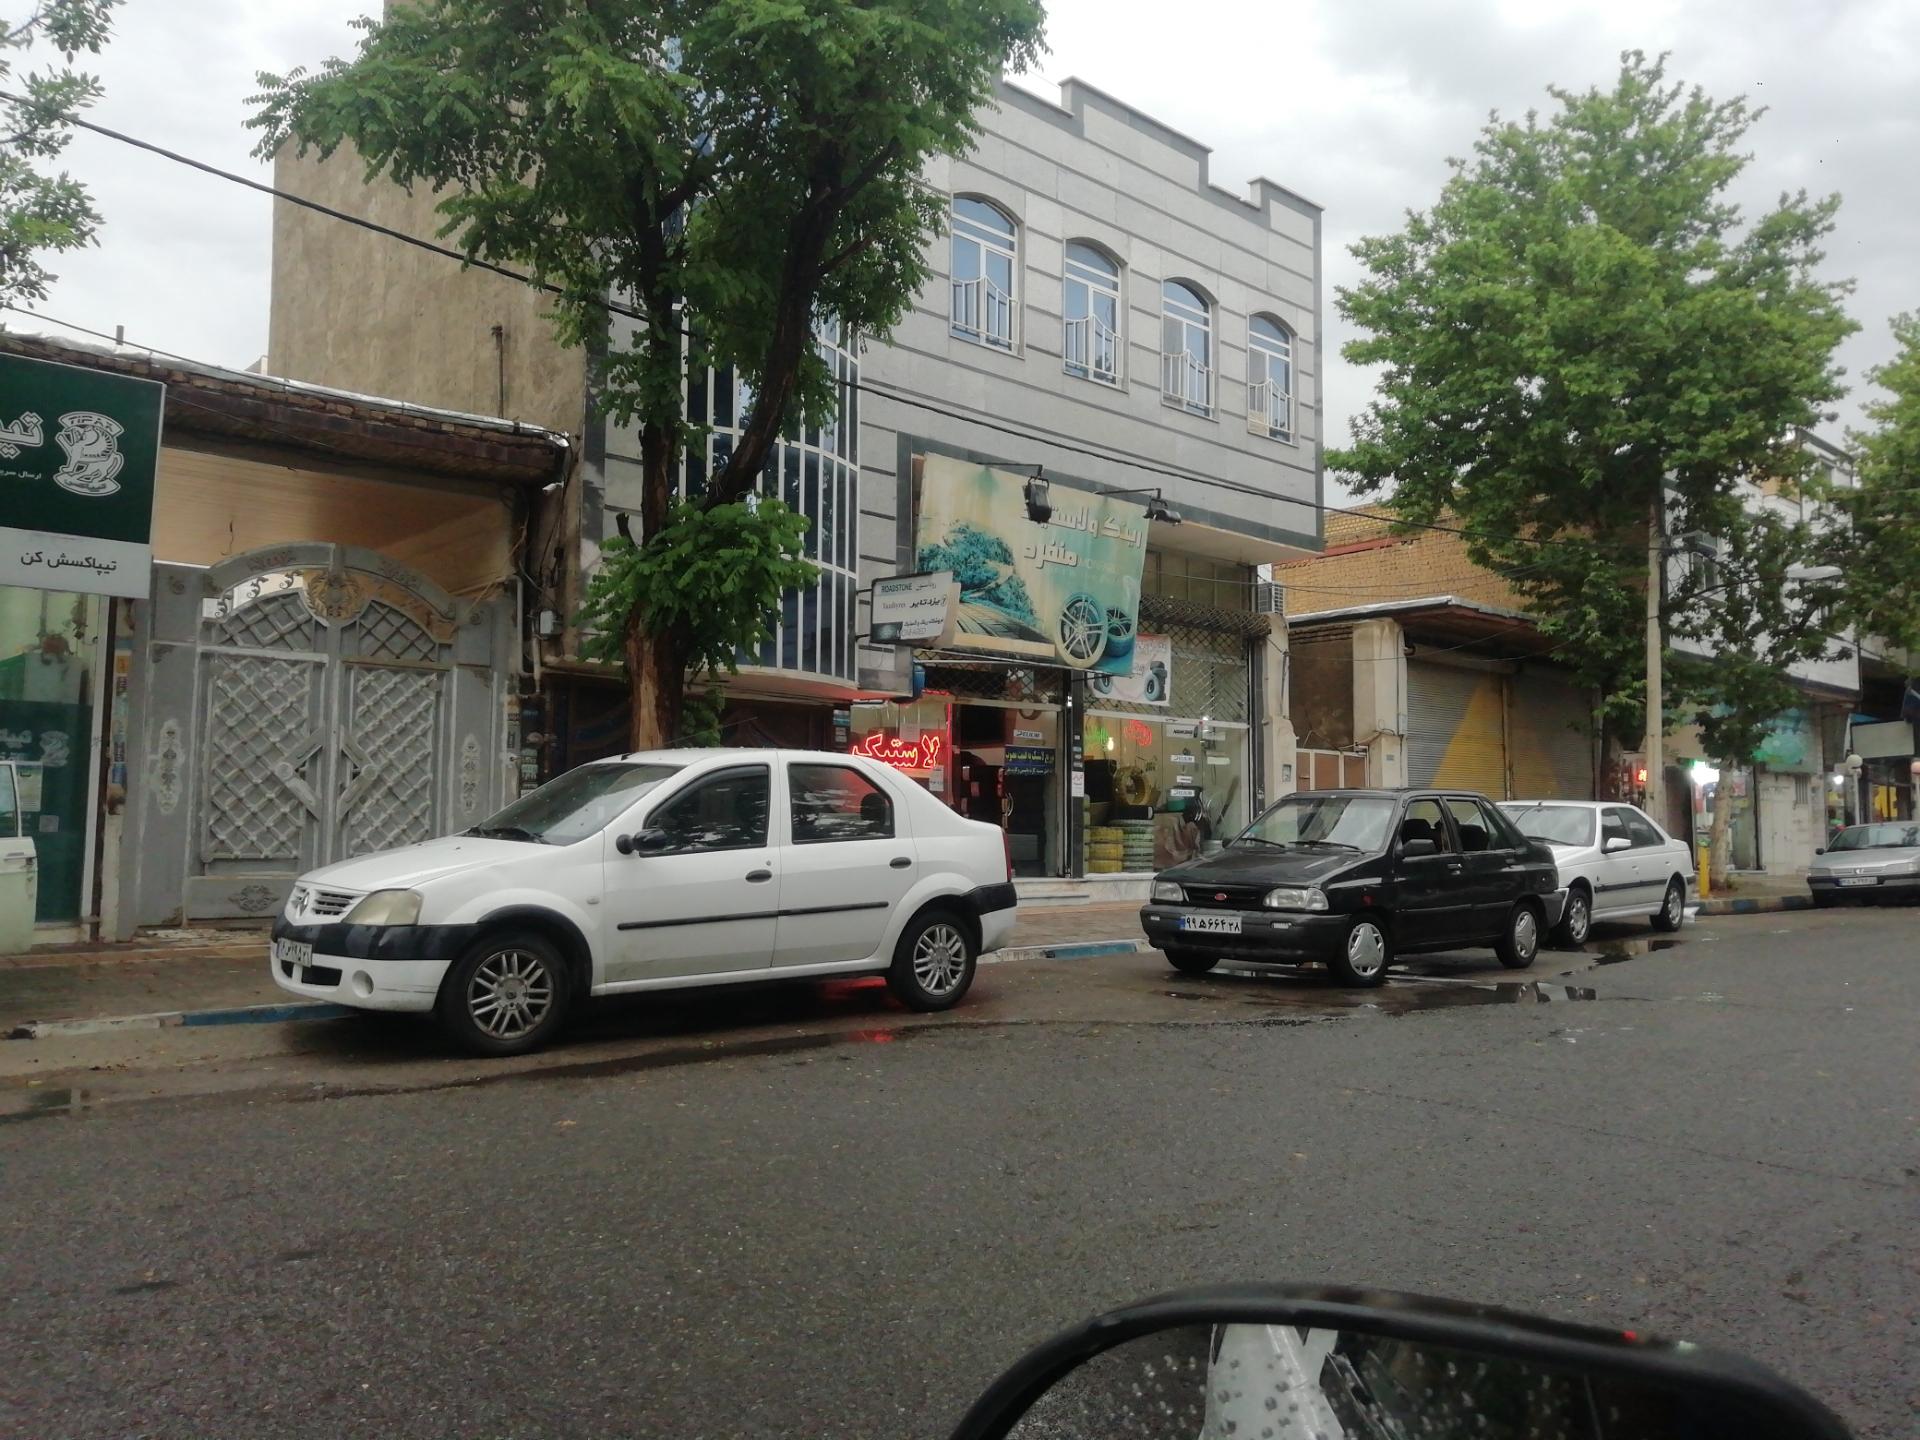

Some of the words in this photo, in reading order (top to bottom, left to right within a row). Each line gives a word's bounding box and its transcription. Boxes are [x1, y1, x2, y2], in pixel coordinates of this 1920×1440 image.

[18, 471, 42, 480] ارسال
[21, 551, 43, 565] کن
[1023, 539, 1079, 569] منفرد
[47, 552, 117, 576] تیپاکسش
[881, 583, 913, 593] ROADSTONE
[852, 733, 940, 769] لاستیک
